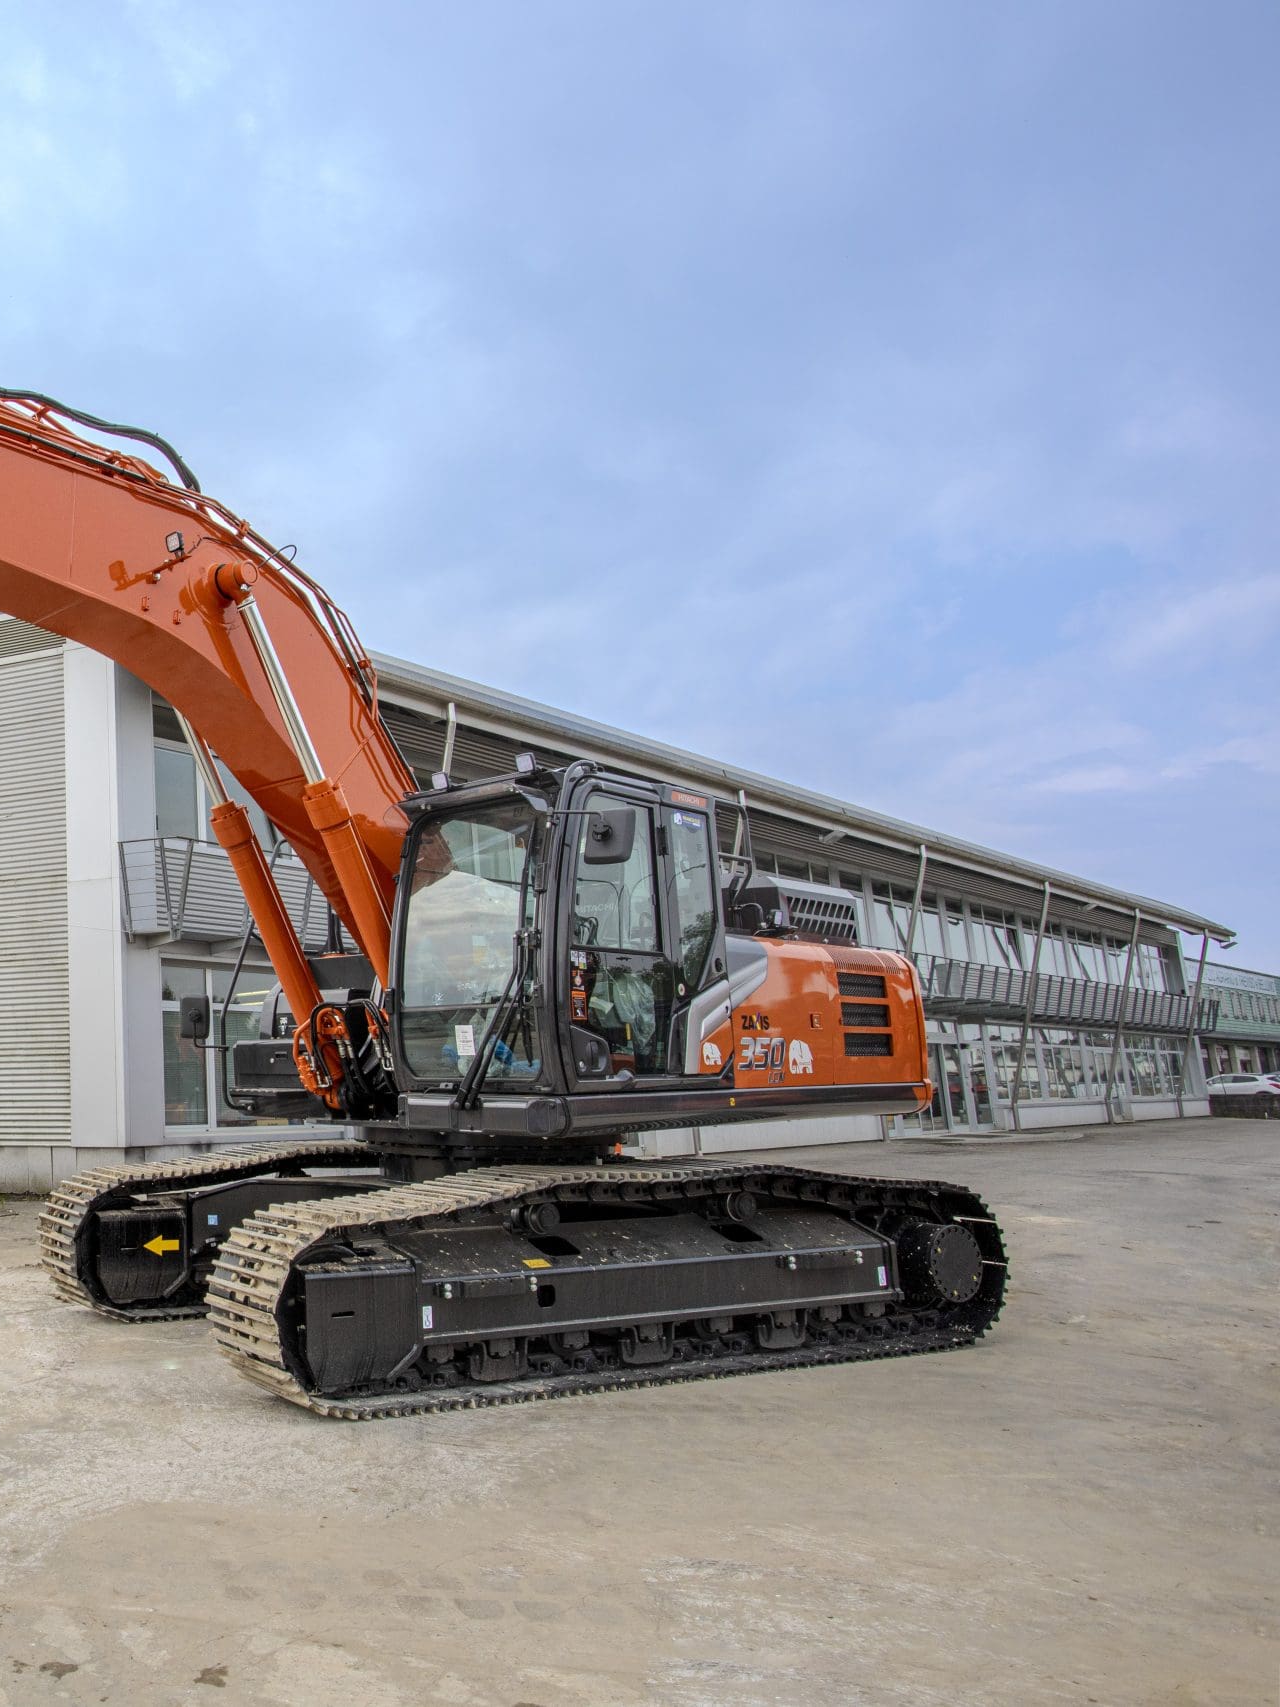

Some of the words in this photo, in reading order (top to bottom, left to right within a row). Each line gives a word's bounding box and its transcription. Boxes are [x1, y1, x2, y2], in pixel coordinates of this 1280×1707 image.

[678, 793, 700, 806] HITACHI
[741, 1012, 769, 1030] ZAXIS
[738, 1037, 786, 1070] 350
